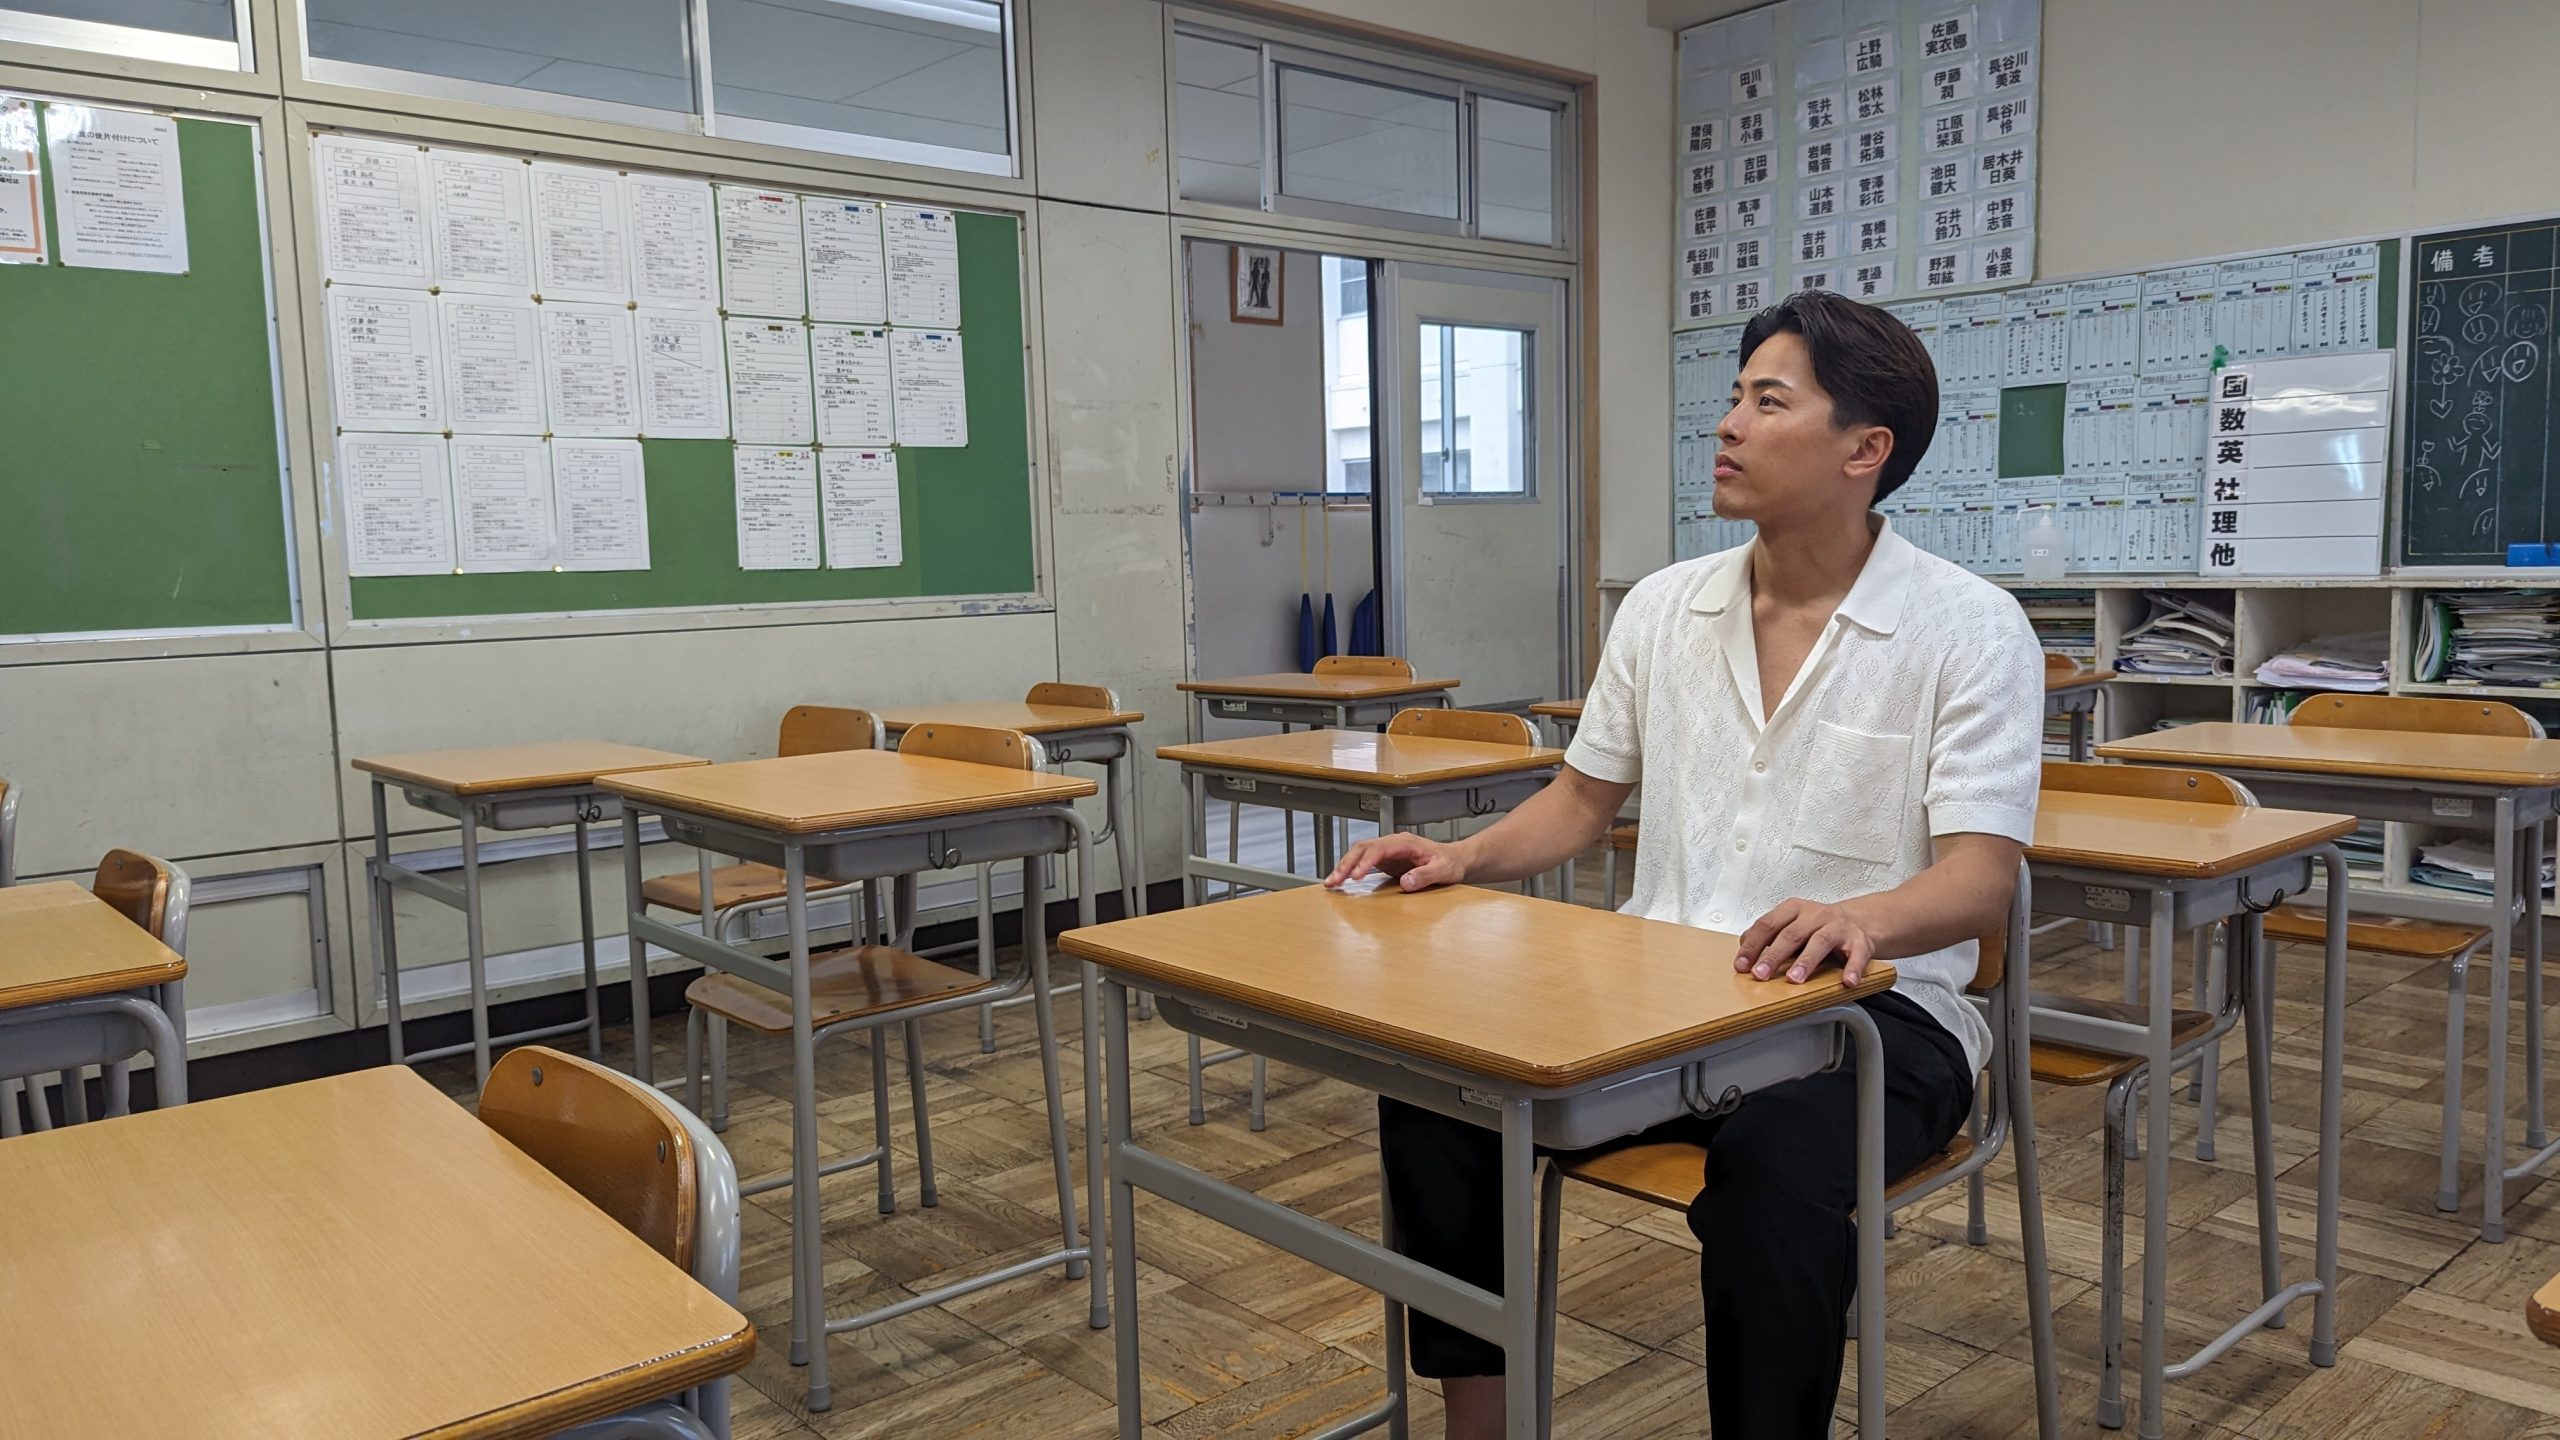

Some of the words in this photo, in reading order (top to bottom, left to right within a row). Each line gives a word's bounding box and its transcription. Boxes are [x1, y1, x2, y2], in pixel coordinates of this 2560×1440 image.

[1931, 19, 1959, 40] 佐藤
[1856, 38, 1882, 56] 上野
[1857, 53, 1882, 69] 広騎
[1988, 50, 2028, 73] 長谷川
[1740, 69, 1762, 87] 田川
[1934, 69, 1961, 87] 伊藤
[1995, 69, 2021, 88] 美波
[1746, 84, 1758, 99] 優
[1858, 86, 1884, 104] 松林
[1807, 98, 1831, 114] 荒井
[1858, 102, 1885, 118] 悠太
[1986, 99, 2026, 122] 長谷川
[1740, 114, 1762, 130] 若月
[1936, 114, 1964, 132] 江原
[1740, 128, 1764, 142] 小春
[1859, 131, 1885, 148] 増谷
[1689, 136, 1712, 152] 陽向
[1743, 154, 1768, 171] 吉田
[1859, 146, 1885, 162] 拓海
[1982, 150, 2024, 171] 居木井
[1692, 166, 1714, 181] 宮村
[1808, 157, 1832, 174] 陽音
[1931, 163, 1956, 182] 池田
[1743, 169, 1768, 184] 拓夢
[1989, 167, 2017, 184] 日葵
[1809, 186, 1833, 202] 山本
[1930, 179, 1957, 196] 健大
[1859, 189, 1885, 207] 彩花
[1693, 205, 1716, 220] 佐藤
[1986, 199, 2014, 216] 中野
[1694, 219, 1717, 234] 航平
[1743, 212, 1755, 227] 円
[1935, 209, 1962, 227] 石井
[1986, 213, 2014, 231] 志音
[1802, 230, 1826, 246] 吉井
[1935, 222, 1962, 241] 鈴乃
[1737, 239, 1759, 254] 羽田
[1802, 244, 1826, 258] 優月
[1861, 234, 1887, 251] 典太
[1686, 245, 1719, 262] 長谷川
[1736, 252, 1760, 269] 雄哉
[1986, 246, 2013, 263] 小泉
[2430, 244, 2495, 273] 備考
[1986, 261, 2013, 278] 香菜
[1689, 288, 1712, 304] 鈴木
[1736, 281, 1759, 296] 渡辺
[1862, 280, 1876, 295] 葵
[1737, 294, 1759, 310] 悠乃
[2222, 373, 2249, 400] 国
[2218, 406, 2246, 433] 数
[2217, 440, 2244, 466] 英
[2214, 475, 2241, 502] 社
[2211, 509, 2238, 535] 理
[2210, 543, 2237, 568] 他
